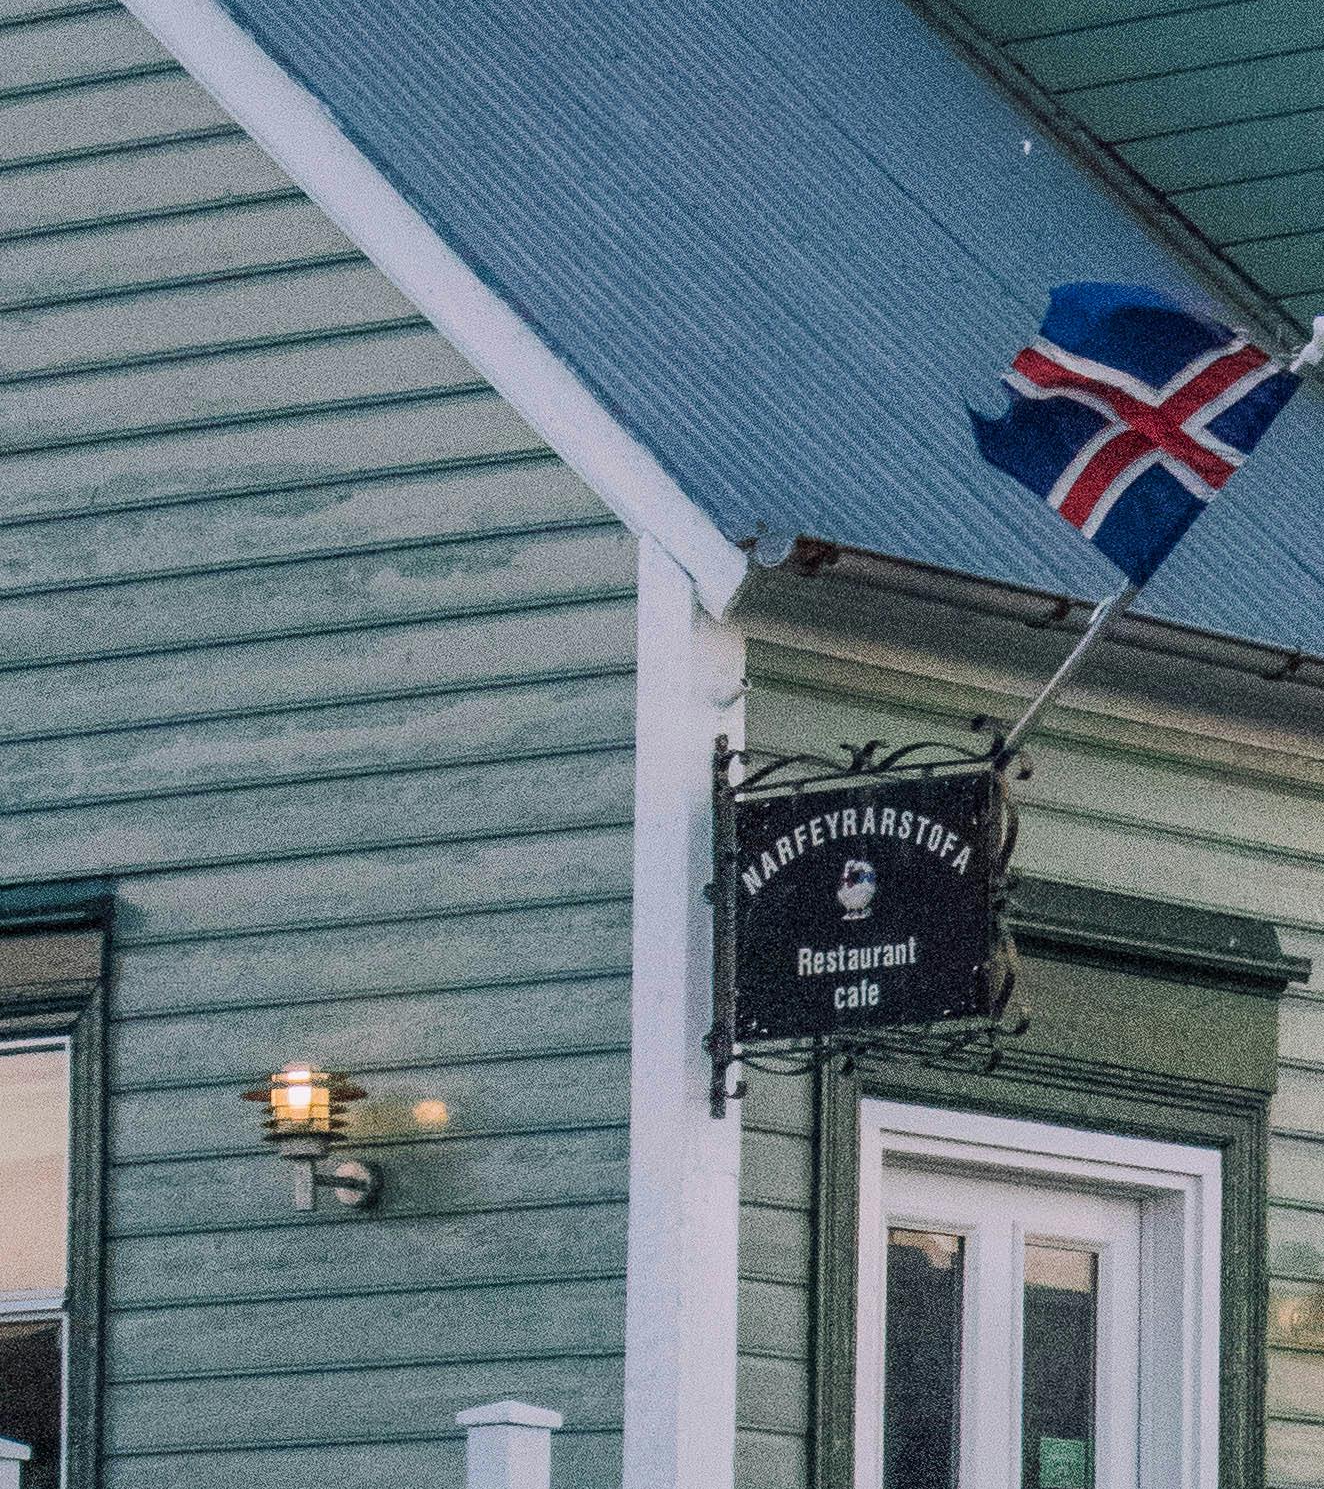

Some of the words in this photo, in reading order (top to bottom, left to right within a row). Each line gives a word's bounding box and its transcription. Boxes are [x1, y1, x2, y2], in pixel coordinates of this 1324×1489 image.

[741, 807, 971, 896] NARFEYRARSTOFA
[798, 936, 916, 976] Restaurant
[834, 978, 880, 1009] cafe
